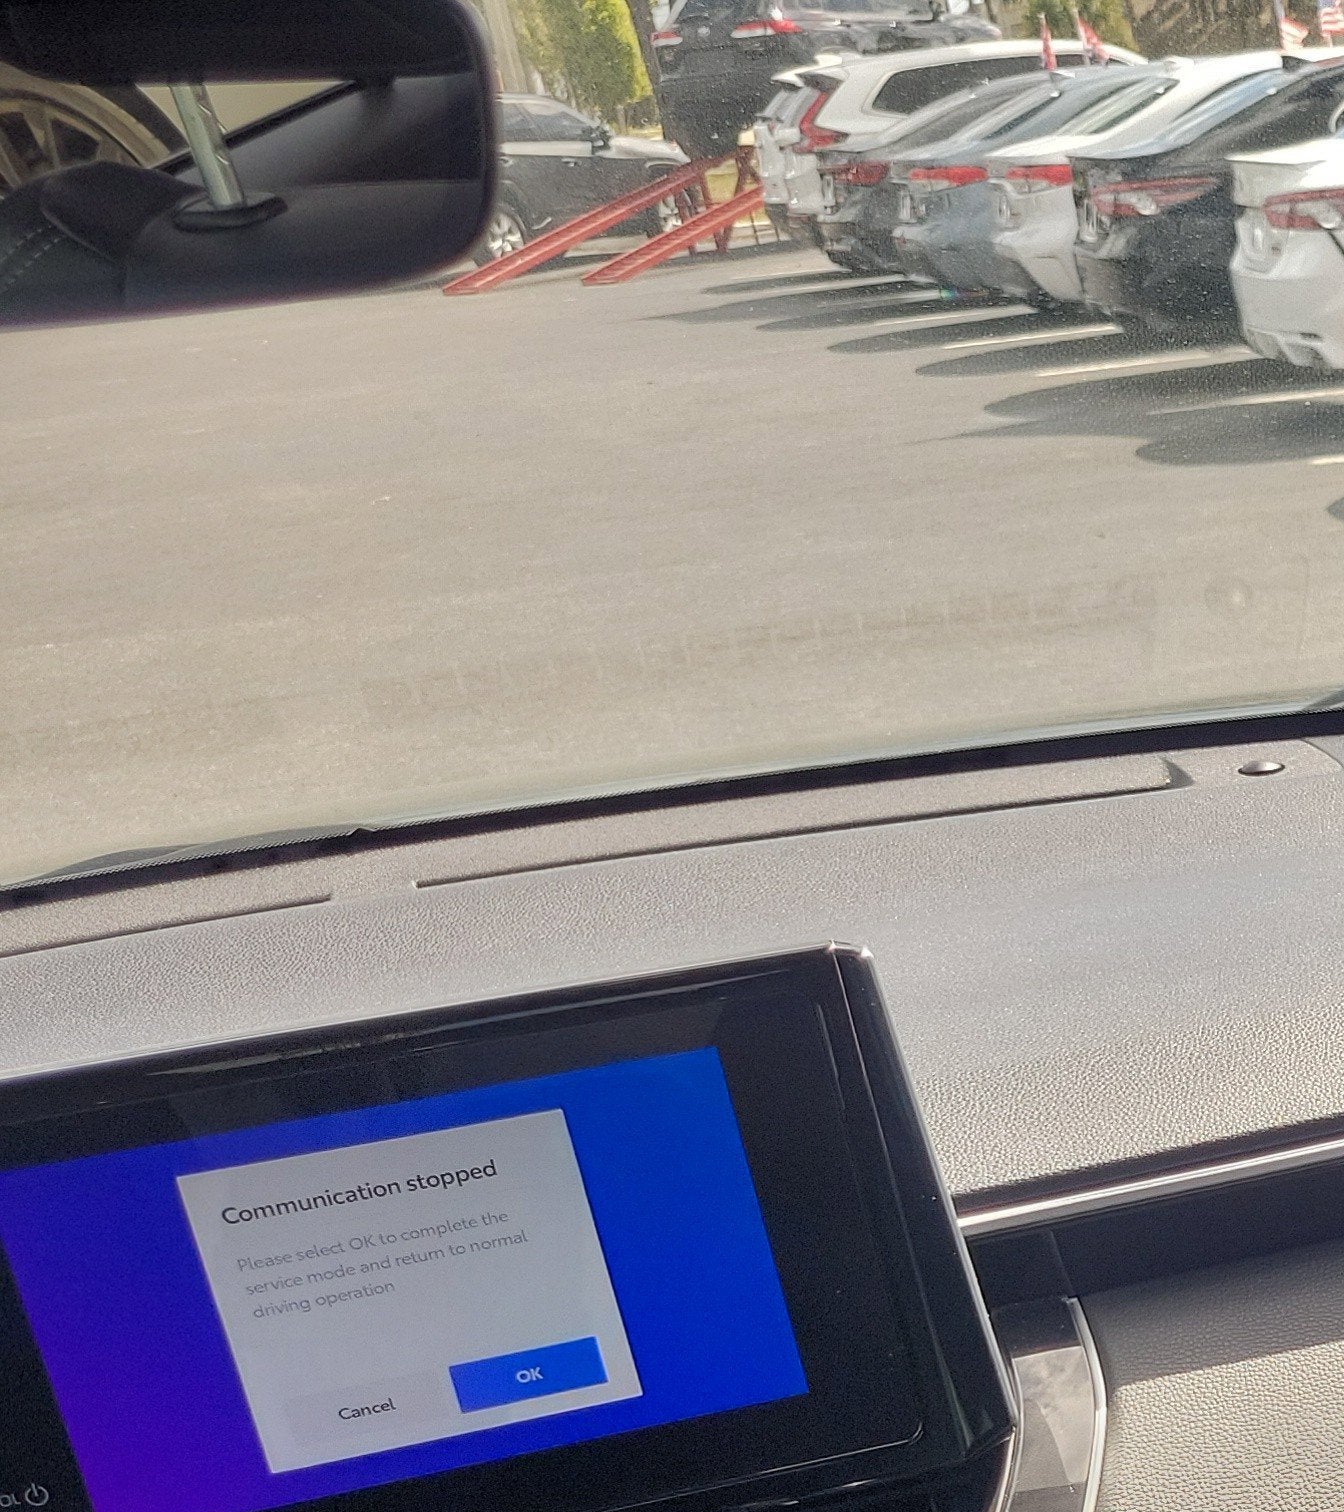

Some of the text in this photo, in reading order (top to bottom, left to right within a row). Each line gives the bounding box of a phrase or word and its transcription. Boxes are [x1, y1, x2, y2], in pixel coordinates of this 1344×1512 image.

[221, 1159, 498, 1225] Communication stopped
[237, 1210, 510, 1272] Please select OK to complete the
[246, 1229, 529, 1296] service mode and return to normal
[253, 1280, 395, 1319] driving operation
[515, 1366, 544, 1384] OK
[338, 1397, 397, 1421] Cancel
